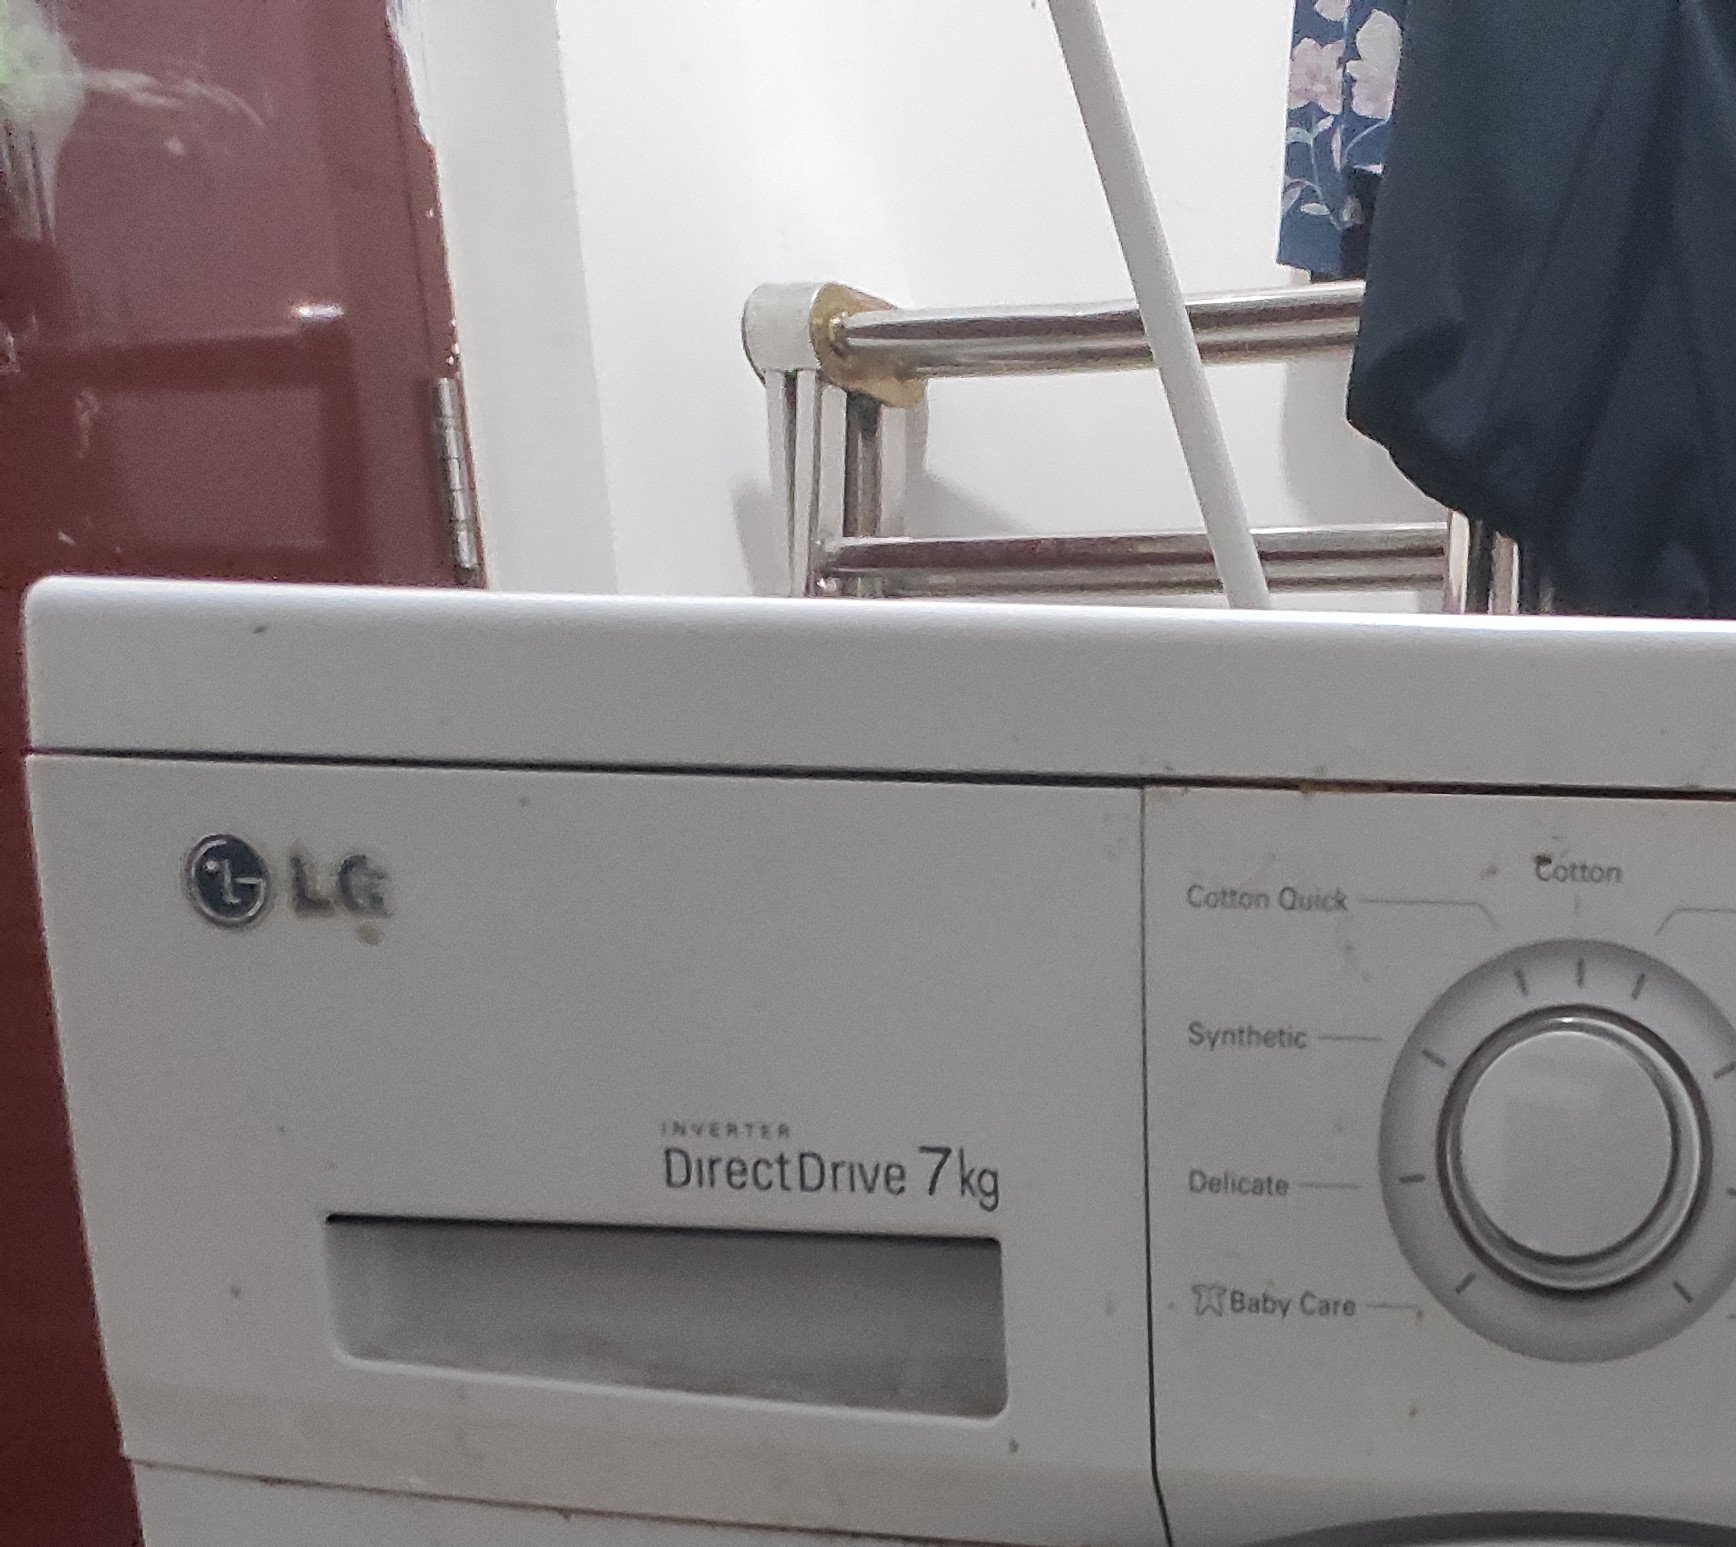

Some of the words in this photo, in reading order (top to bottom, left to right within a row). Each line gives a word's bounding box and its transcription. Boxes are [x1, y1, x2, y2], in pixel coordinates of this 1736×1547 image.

[1534, 858, 1622, 883] Cotton
[289, 854, 392, 918] LG
[1186, 884, 1270, 910] Cotton
[1279, 885, 1349, 912] Quick
[1188, 1020, 1308, 1051] Synthetic
[660, 1119, 791, 1139] INVERTER
[1188, 1168, 1290, 1197] Delicate
[1230, 1288, 1292, 1319] Baby
[1299, 1289, 1356, 1317] Care
